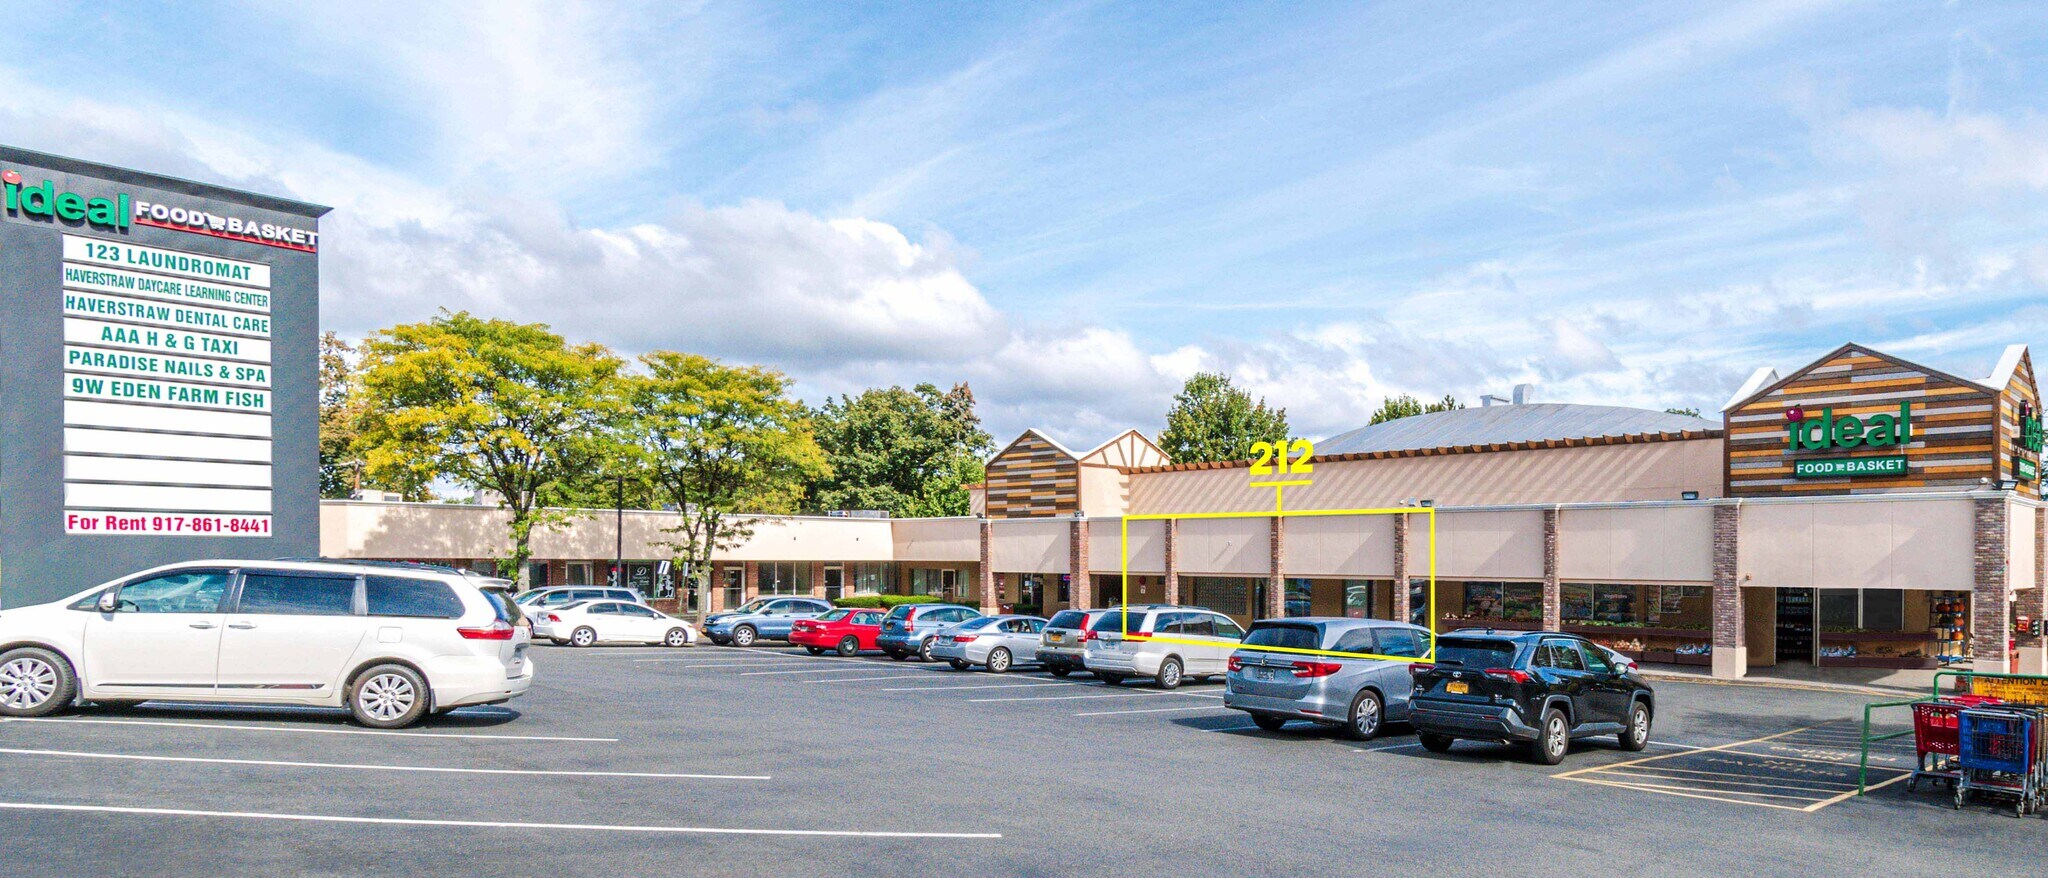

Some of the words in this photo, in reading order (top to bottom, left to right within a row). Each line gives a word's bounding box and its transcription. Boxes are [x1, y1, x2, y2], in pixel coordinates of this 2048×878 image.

[3, 170, 129, 228] ideal
[135, 200, 205, 225] FOOD
[228, 213, 318, 246] BASKET
[86, 243, 120, 260] 123
[127, 248, 251, 281] LAUNDROMAT
[66, 268, 135, 289] HAVERSTRAW
[138, 274, 182, 295] DAYCARE
[185, 284, 231, 302] LEARNING
[234, 289, 268, 307] CENTER
[66, 296, 170, 321] HAVERSTRAW
[176, 310, 228, 328] DENTAL
[233, 316, 268, 333] CARE
[101, 326, 140, 344] AAA
[147, 331, 158, 347] H
[166, 333, 177, 348] &
[184, 335, 195, 350] G
[201, 338, 238, 355] TAXI
[69, 350, 158, 372] PARADISE
[165, 360, 213, 377] NAILS
[220, 365, 230, 379] &
[236, 366, 266, 383] SPA
[73, 378, 103, 395] 9W
[112, 381, 161, 399] EDEN
[169, 387, 218, 404] FARM
[226, 392, 264, 408] FISH
[1786, 401, 1910, 451] ideal
[1797, 463, 1833, 473] FOOD
[1847, 460, 1904, 471] BASKET
[68, 515, 98, 530] For
[106, 515, 146, 530] Rent
[152, 516, 268, 533] 917-861-8441
